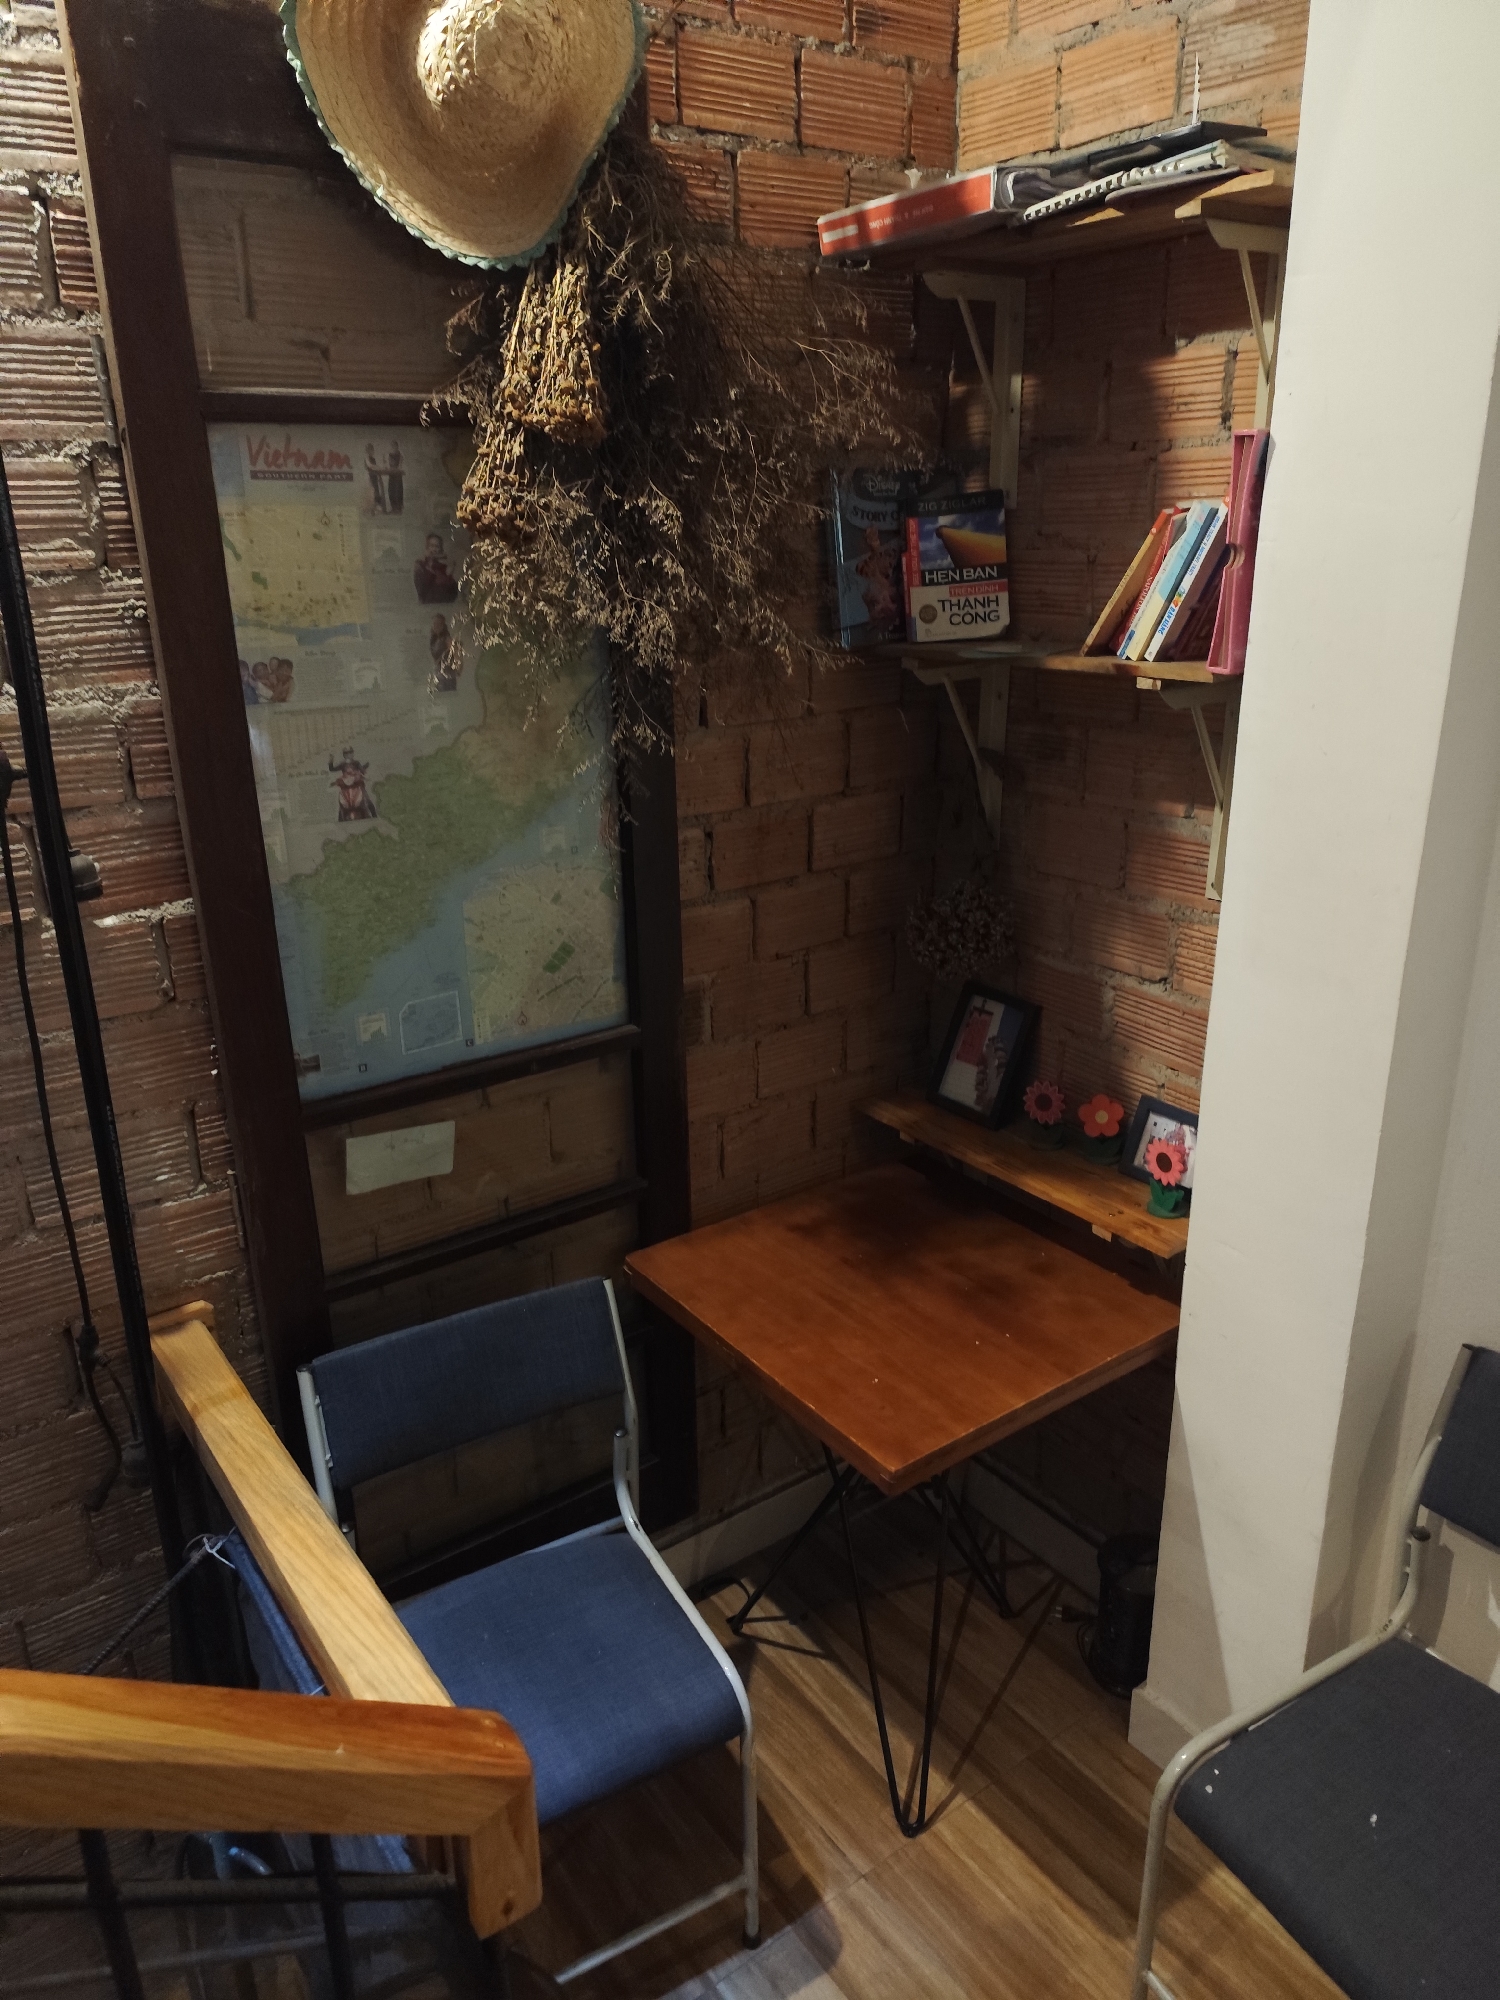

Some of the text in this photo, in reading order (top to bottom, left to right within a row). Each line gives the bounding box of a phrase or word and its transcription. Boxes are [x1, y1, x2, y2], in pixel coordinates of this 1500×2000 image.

[246, 433, 353, 470] Vietnam
[918, 501, 937, 512] ZIG
[925, 566, 998, 584] HẸN BẠN
